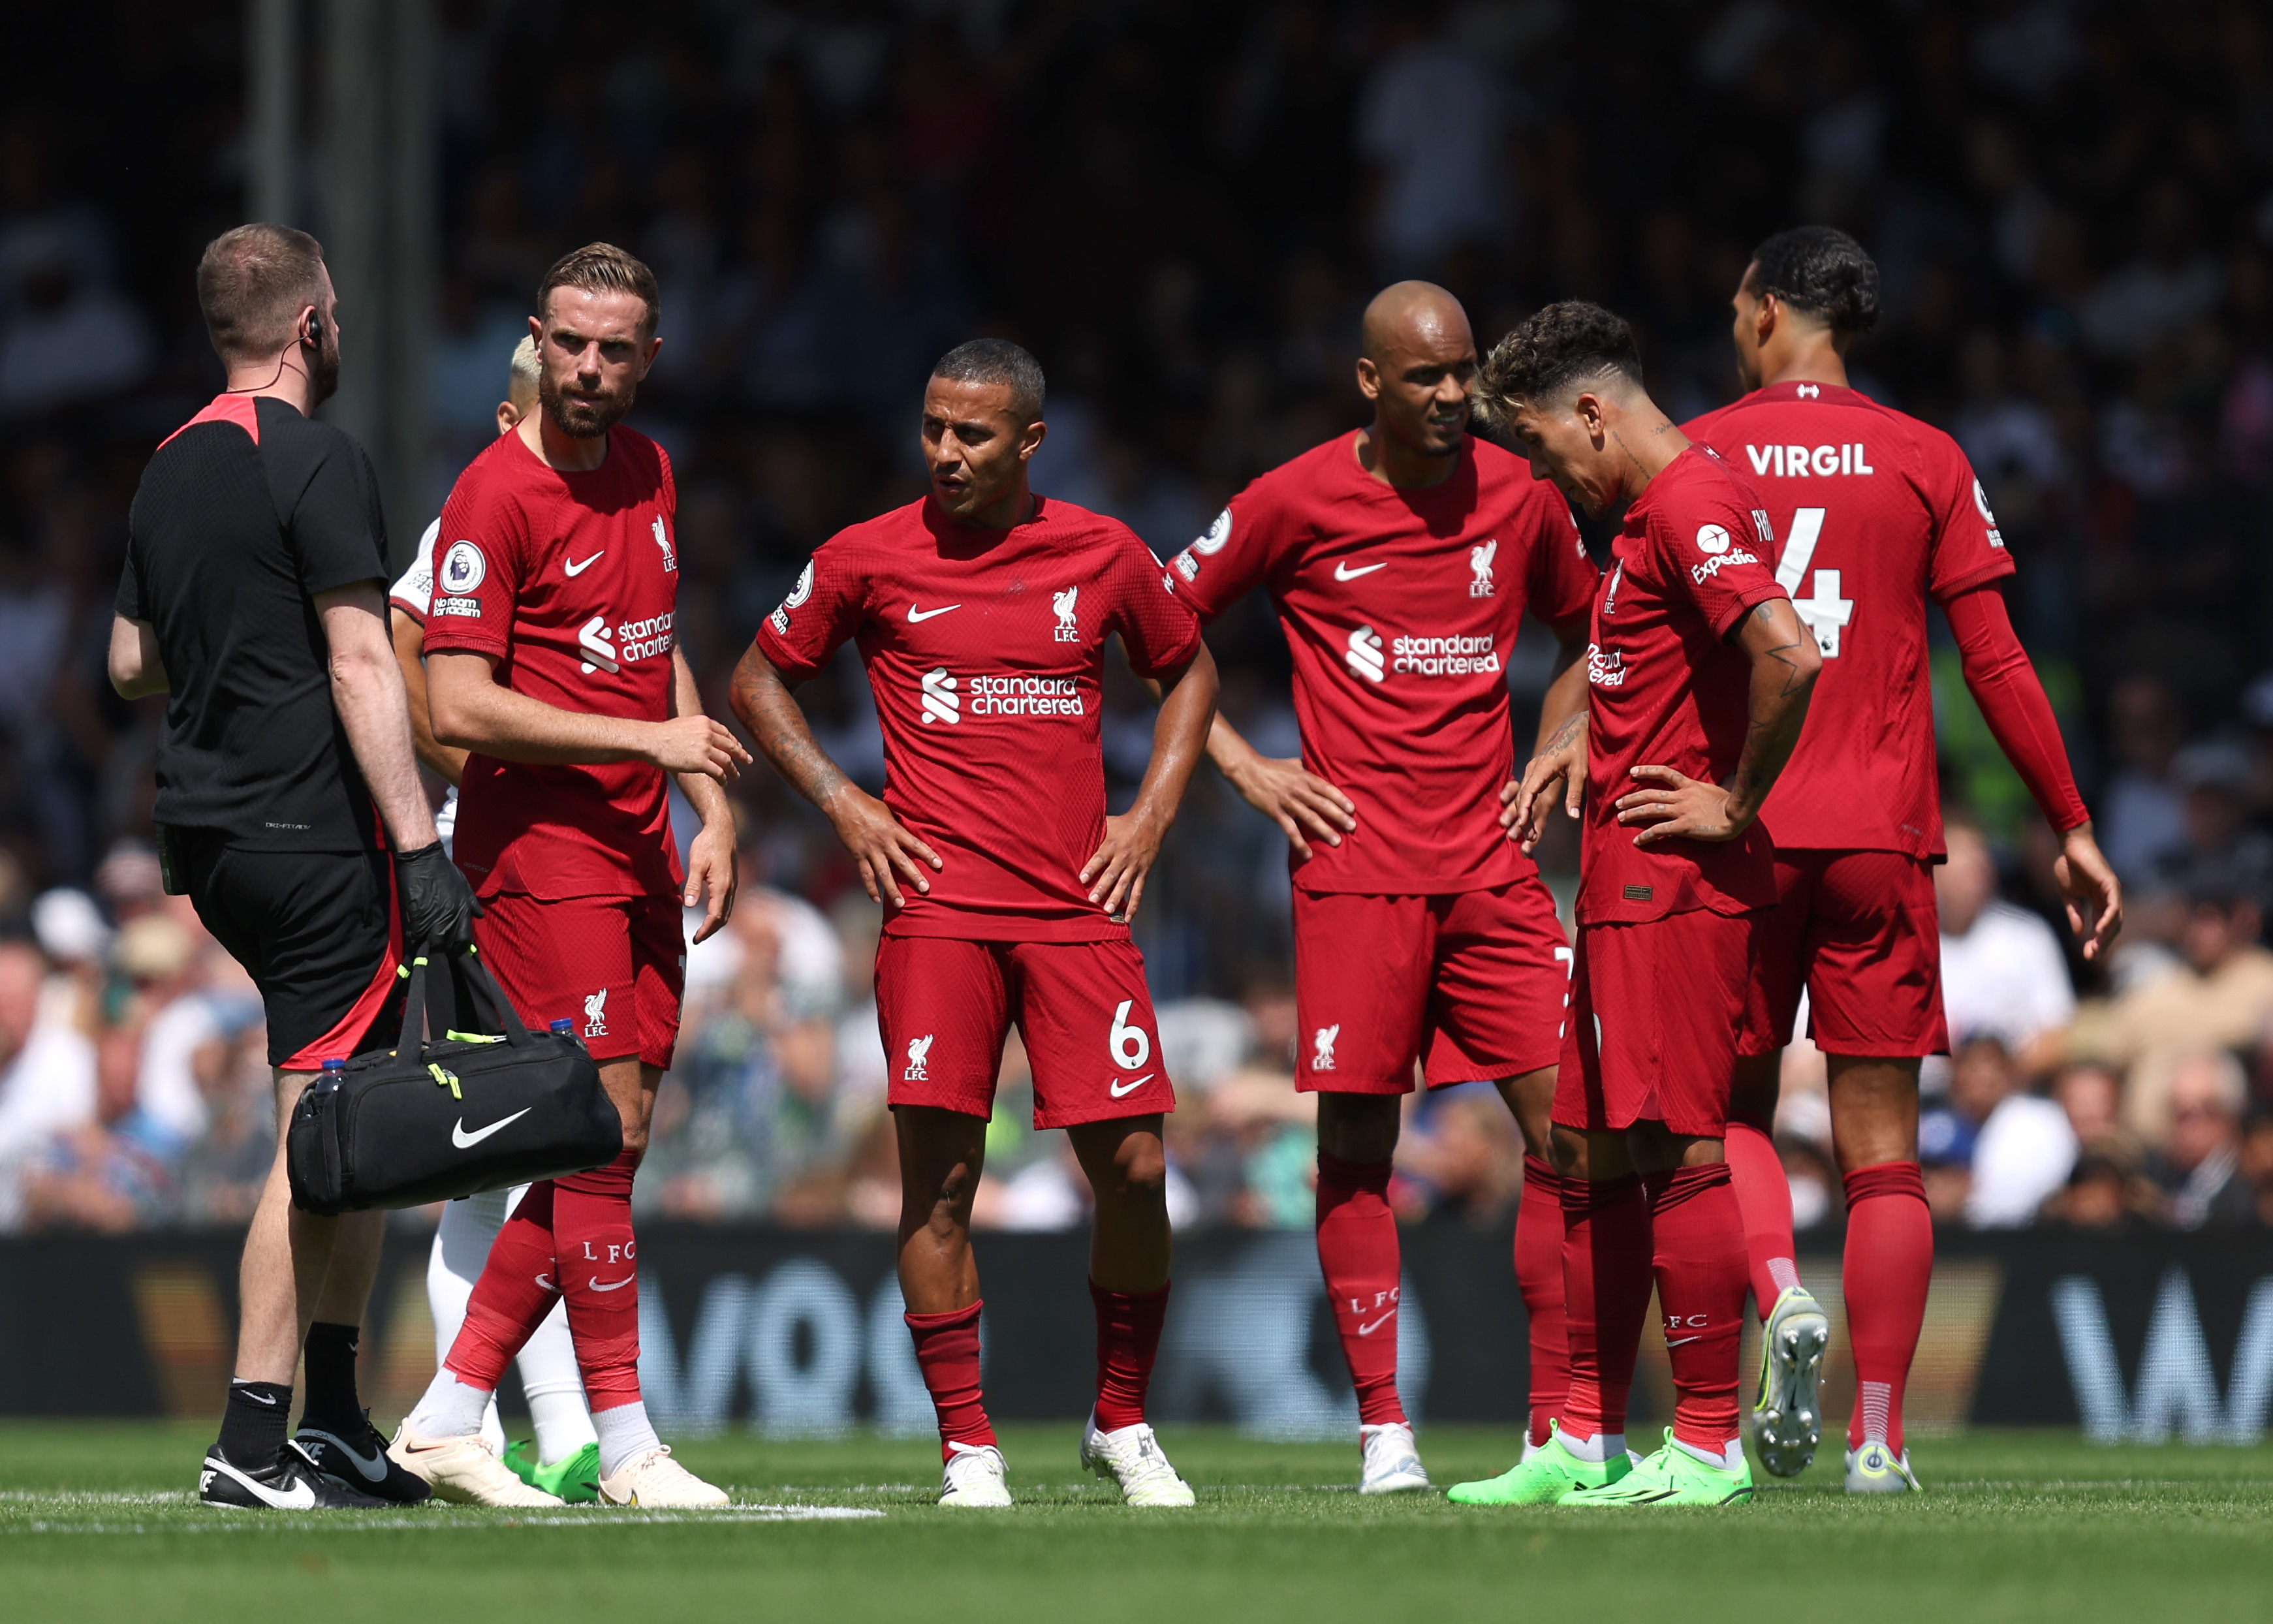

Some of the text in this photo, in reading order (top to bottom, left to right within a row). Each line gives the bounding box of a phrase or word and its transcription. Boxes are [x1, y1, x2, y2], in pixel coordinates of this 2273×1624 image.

[1746, 443, 1874, 477] VIRGIL
[1691, 547, 1759, 585] Expedia
[1775, 507, 1855, 659] 4
[433, 606, 481, 618] for racism
[434, 597, 477, 608] No room
[1392, 632, 1494, 655] standard
[1392, 651, 1501, 676] chartered
[970, 675, 1078, 696] standard
[971, 694, 1084, 715] chartered
[1109, 999, 1150, 1070] 6
